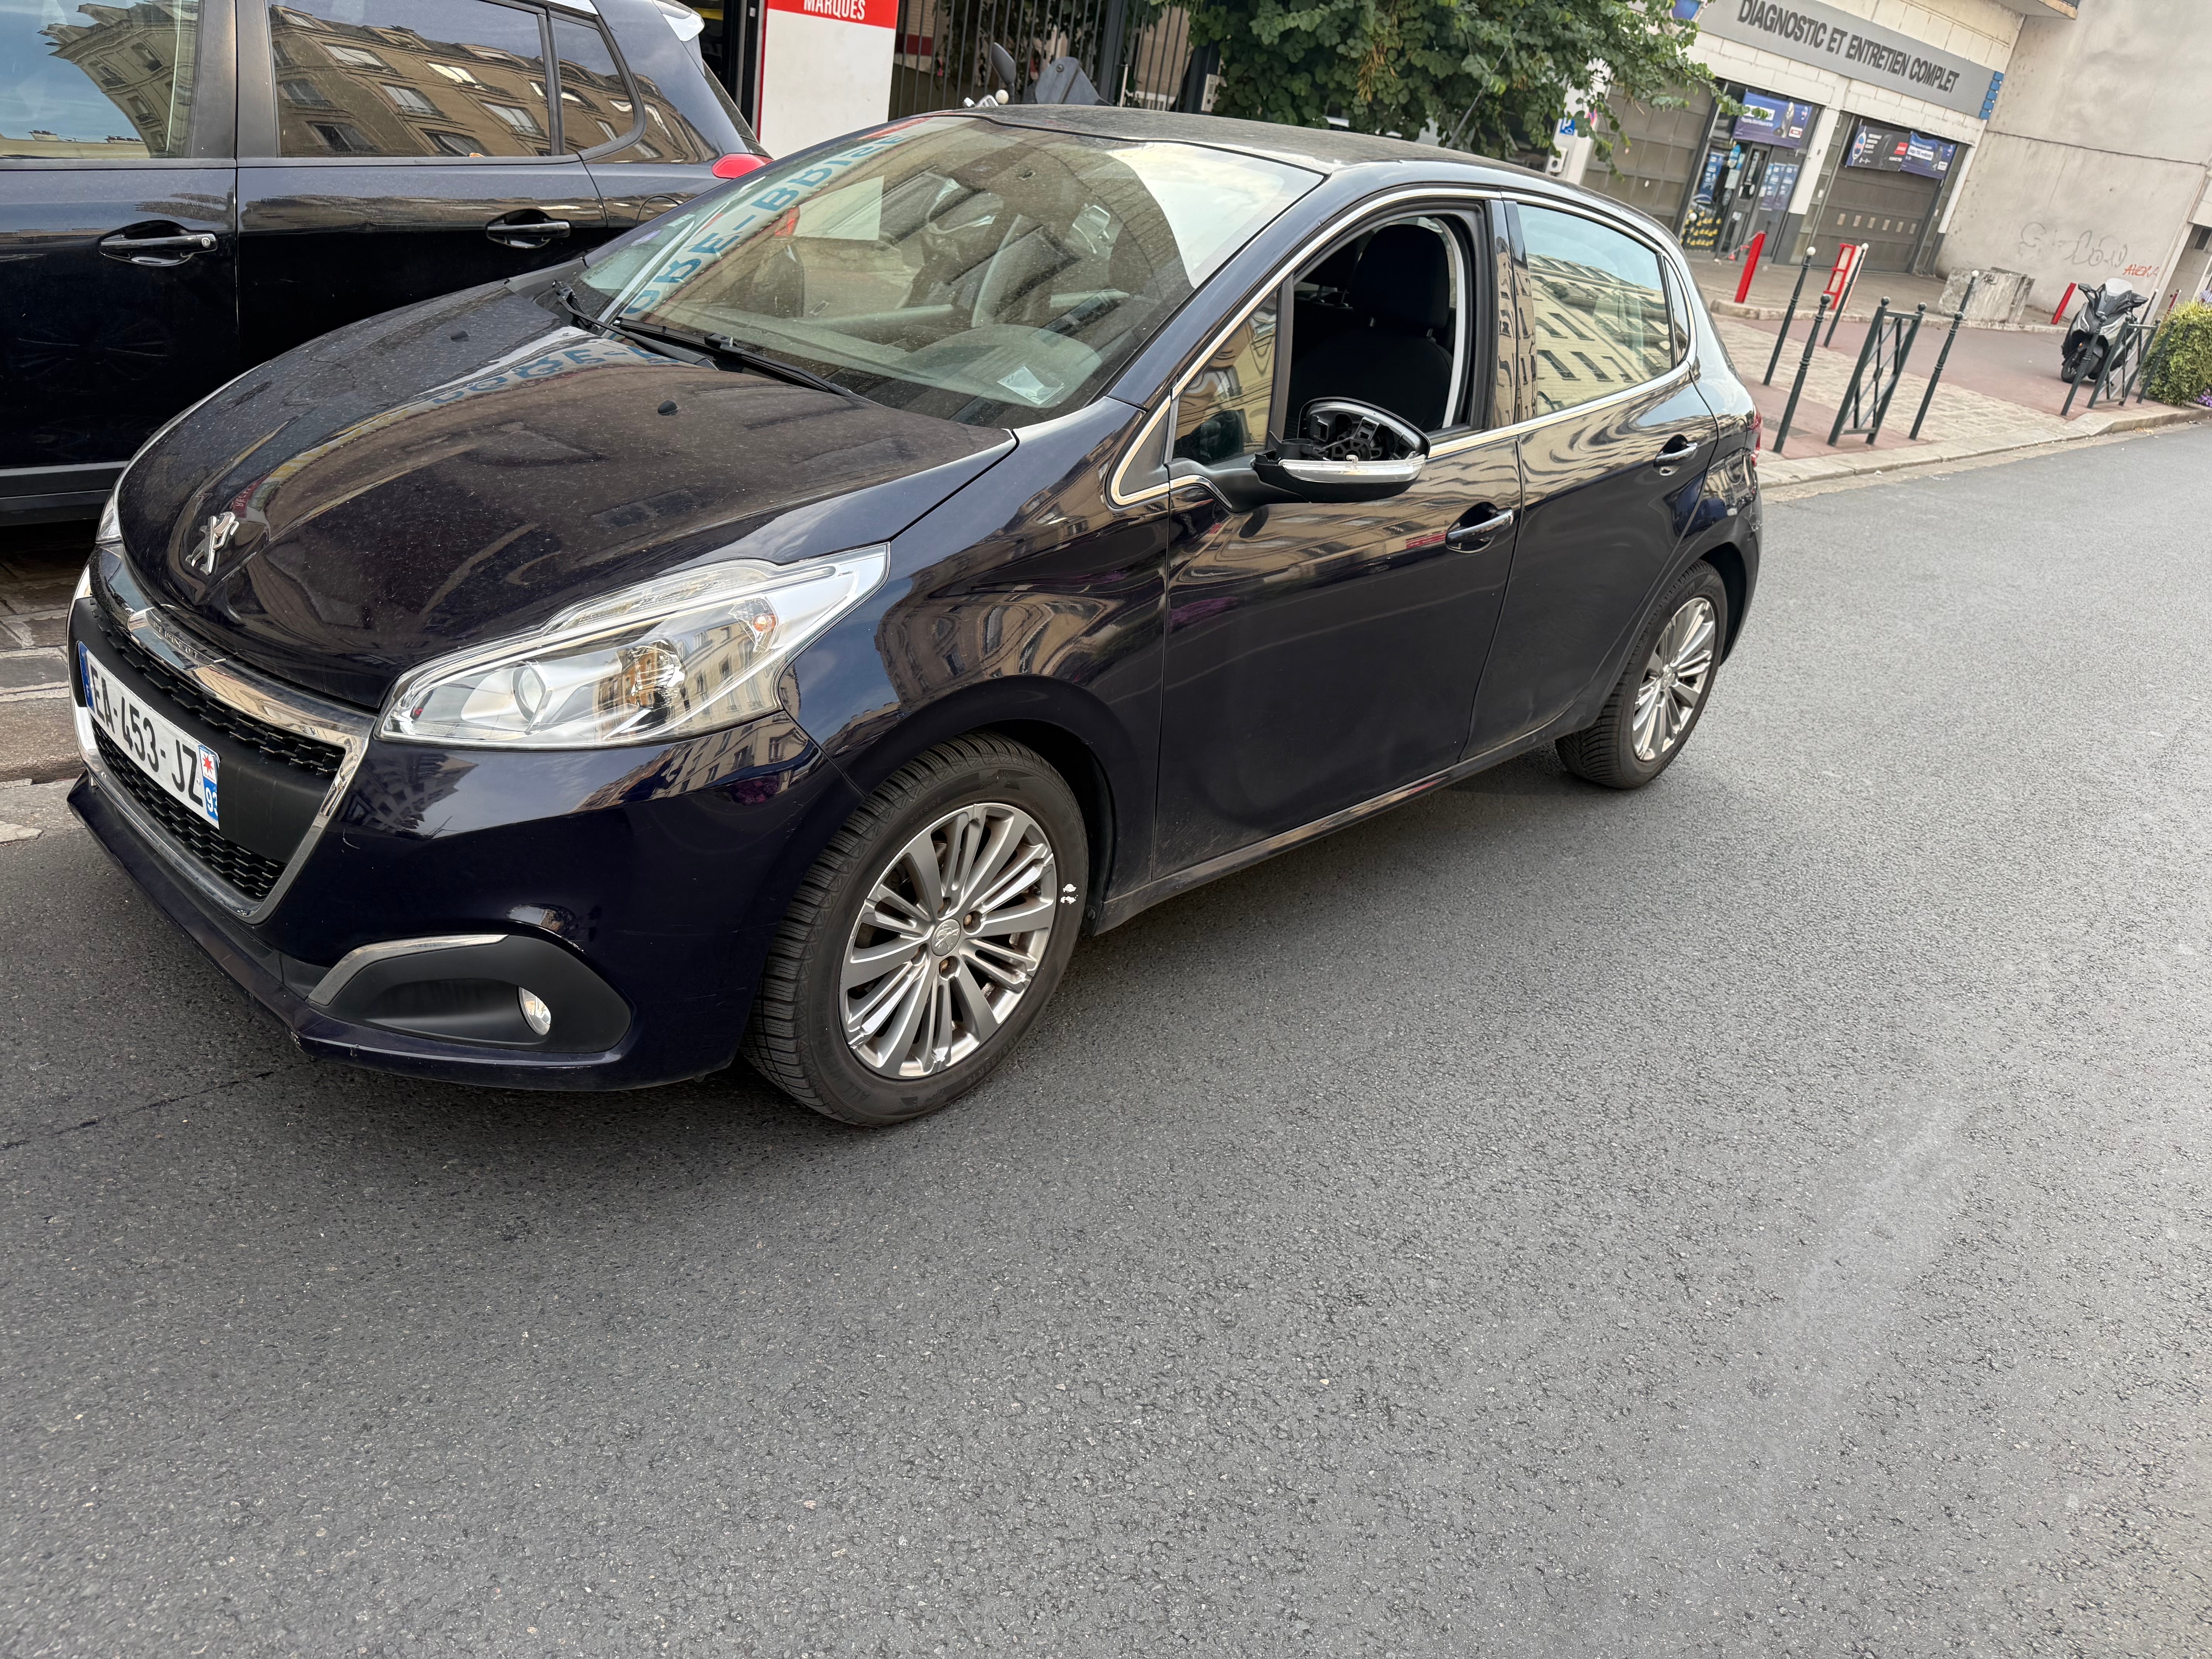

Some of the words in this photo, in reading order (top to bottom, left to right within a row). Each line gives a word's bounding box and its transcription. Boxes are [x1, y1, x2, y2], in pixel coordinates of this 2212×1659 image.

[1737, 0, 1827, 48] DIAGNOSTIC
[1826, 27, 1848, 55] ET
[1845, 34, 1911, 76] ENTRETIEN
[1908, 57, 1960, 93] COMPLET
[90, 664, 203, 807] EA-453-JZ
